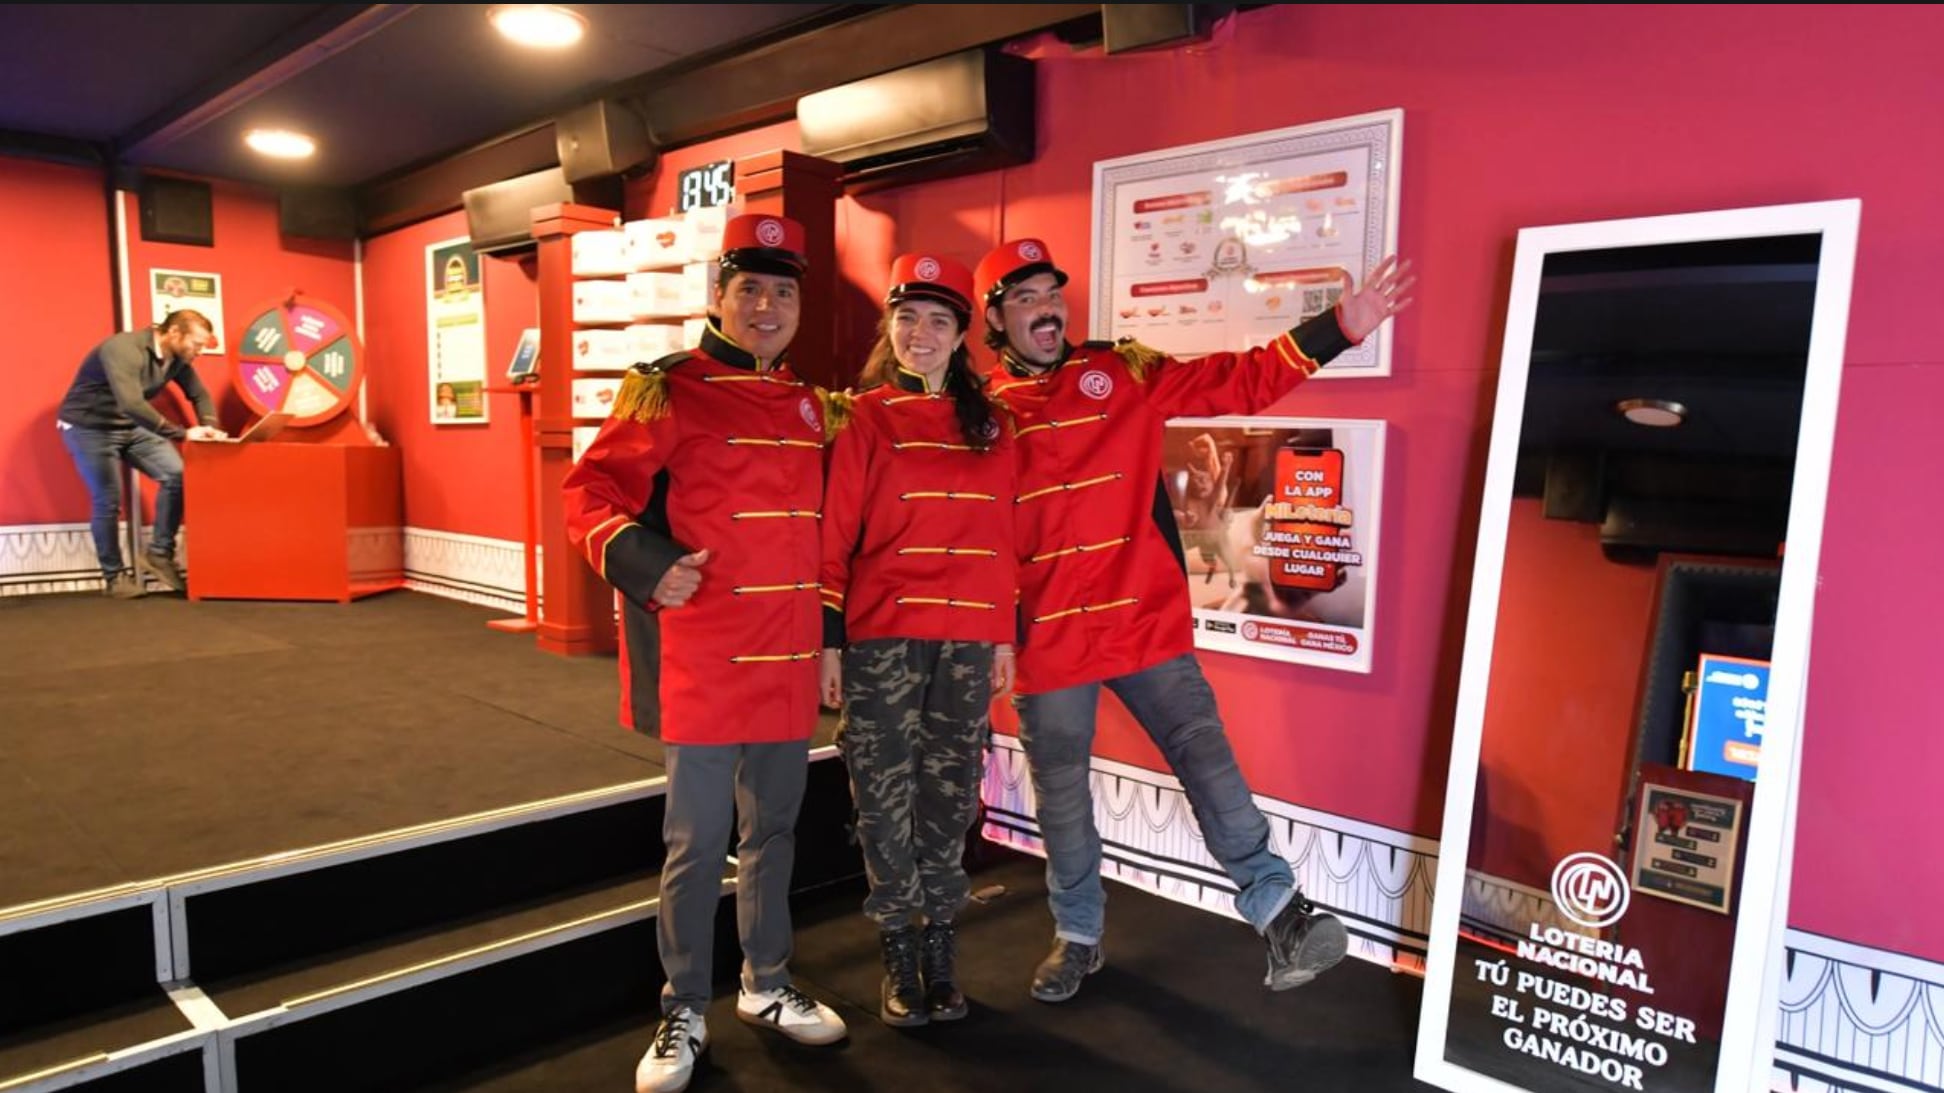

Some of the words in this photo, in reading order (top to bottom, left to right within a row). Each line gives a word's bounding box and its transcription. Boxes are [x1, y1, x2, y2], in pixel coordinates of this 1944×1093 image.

[1284, 485, 1303, 496] LA
[1304, 486, 1333, 498] APP
[1295, 470, 1324, 482] CON
[1253, 545, 1290, 558] DESDE
[1291, 549, 1361, 564] CUALQUIER
[1264, 532, 1300, 544] JUEGA
[1303, 534, 1312, 544] Y
[1314, 536, 1350, 548] GANA
[1283, 562, 1325, 576] LUGAR
[1530, 922, 1645, 970] LOTERIA
[1516, 940, 1655, 995] NACIONAL
[1475, 959, 1510, 987] TÚ
[1516, 971, 1627, 1021] PUEDES
[1636, 1007, 1697, 1043] SER
[1491, 995, 1524, 1023] EL
[1532, 1006, 1669, 1067] PRÓXIMO
[1503, 1027, 1645, 1091] GANADOR
